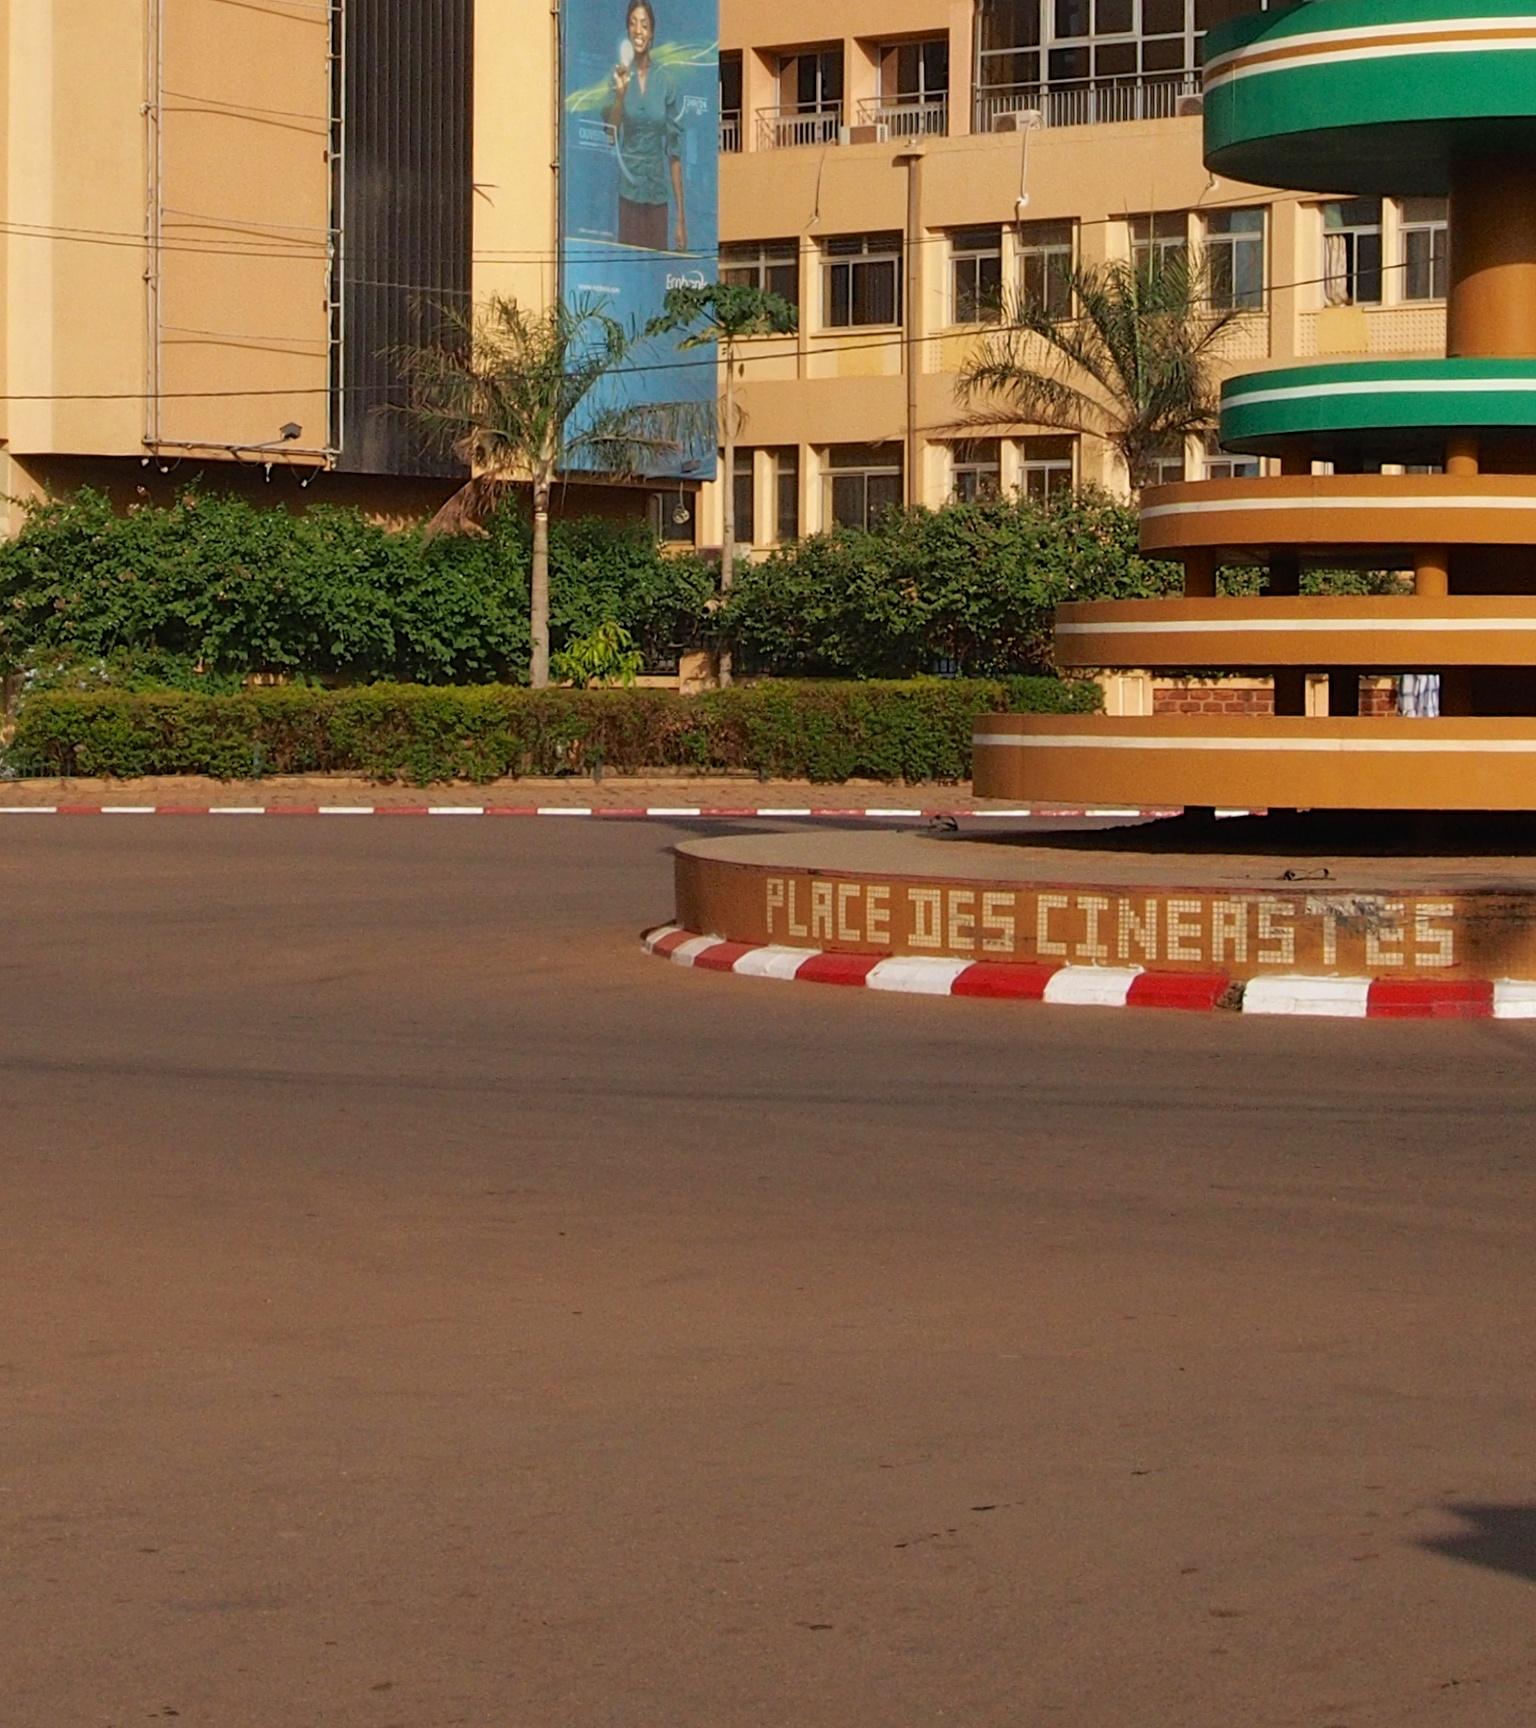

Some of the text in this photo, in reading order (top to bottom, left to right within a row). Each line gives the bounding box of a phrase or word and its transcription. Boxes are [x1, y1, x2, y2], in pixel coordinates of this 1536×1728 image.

[767, 878, 1454, 967] PLACE DES CINEASTES
